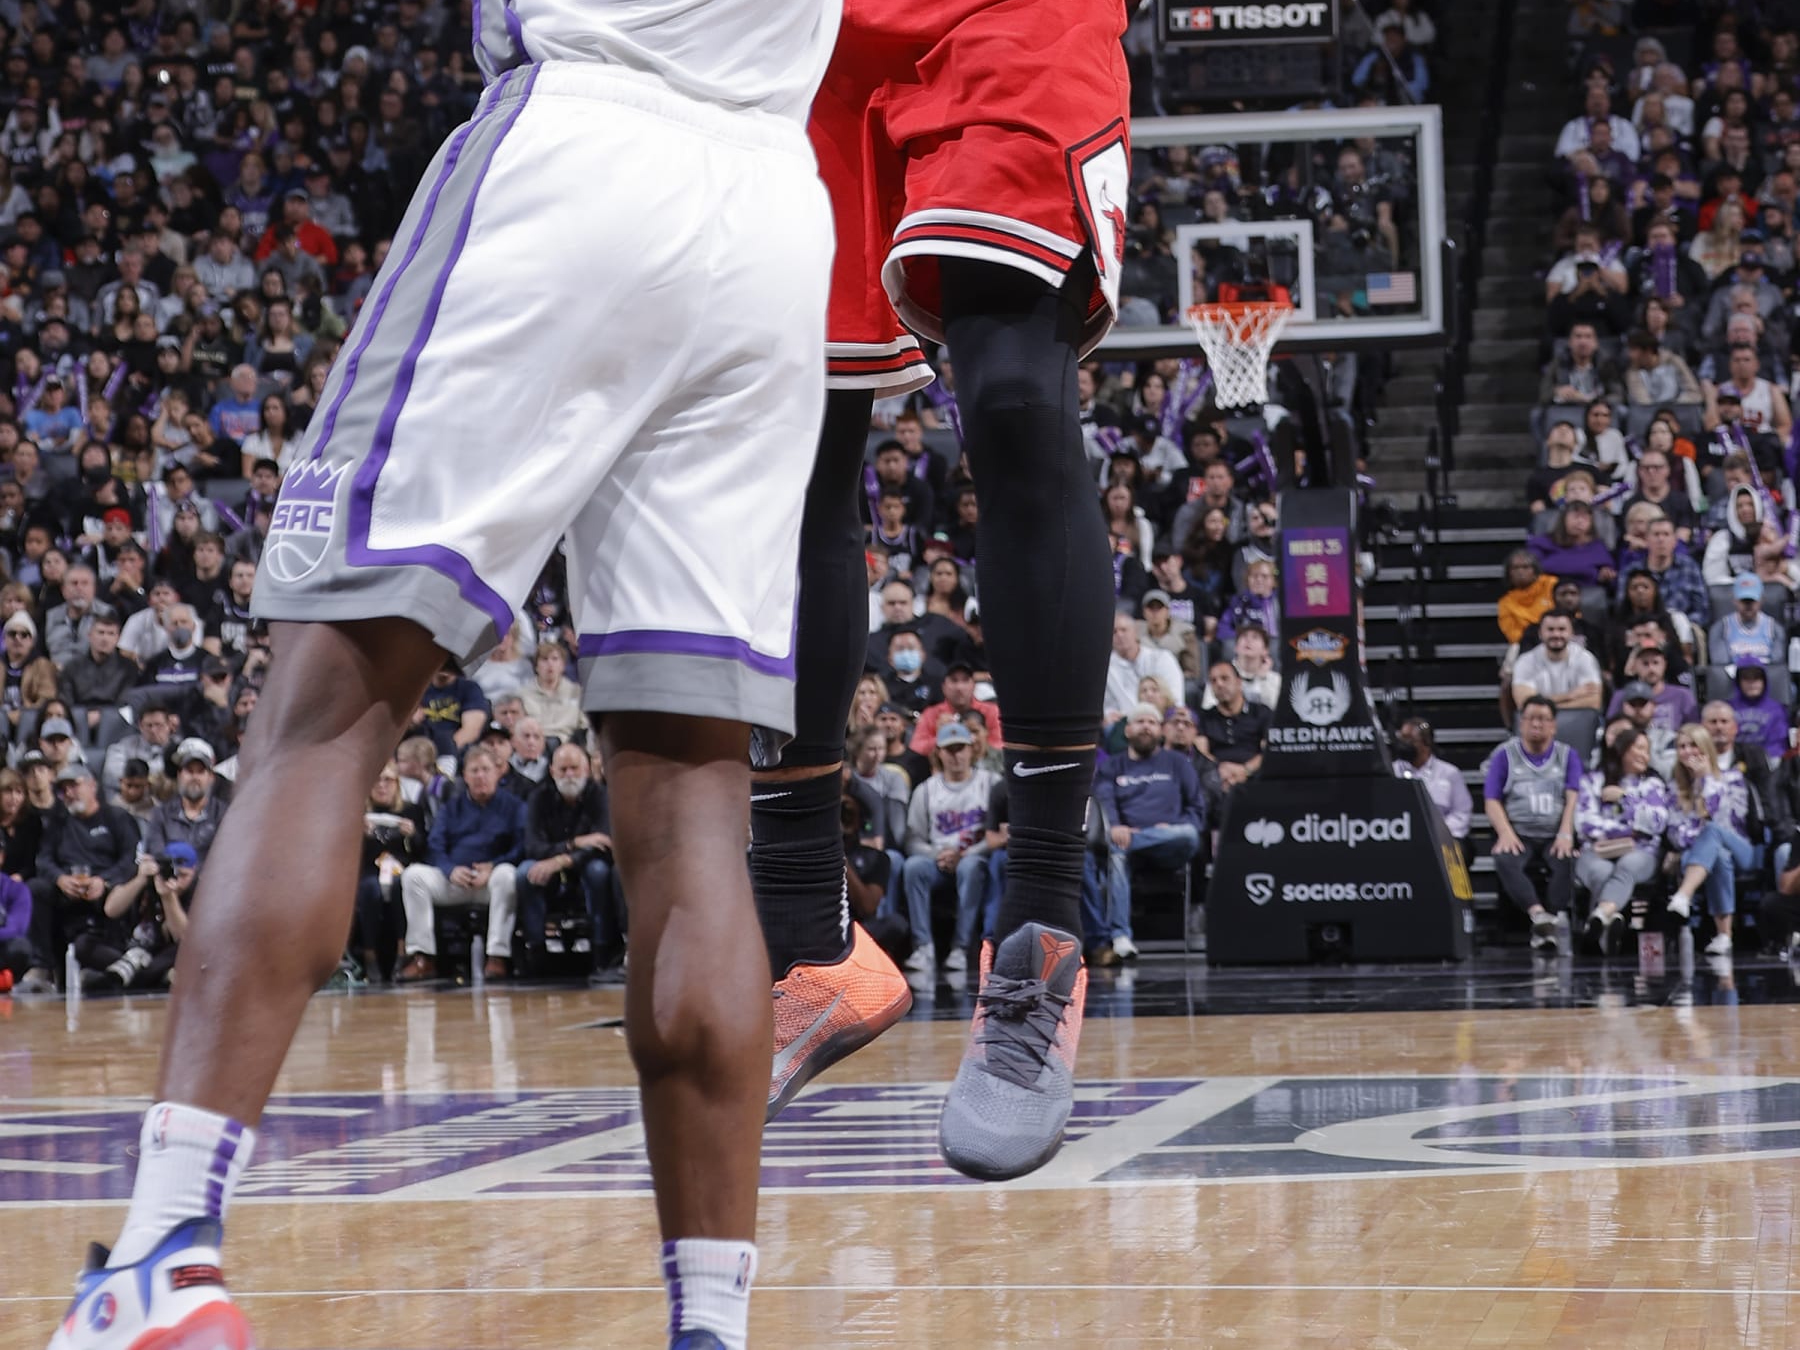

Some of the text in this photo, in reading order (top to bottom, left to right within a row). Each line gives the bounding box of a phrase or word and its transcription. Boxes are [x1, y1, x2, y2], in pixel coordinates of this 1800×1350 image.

[1213, 3, 1328, 30] TISSOT
[271, 504, 334, 533] SAC
[1268, 725, 1375, 744] REDHAWK
[1291, 811, 1411, 848] dialpad
[1282, 880, 1413, 904] socios.com
